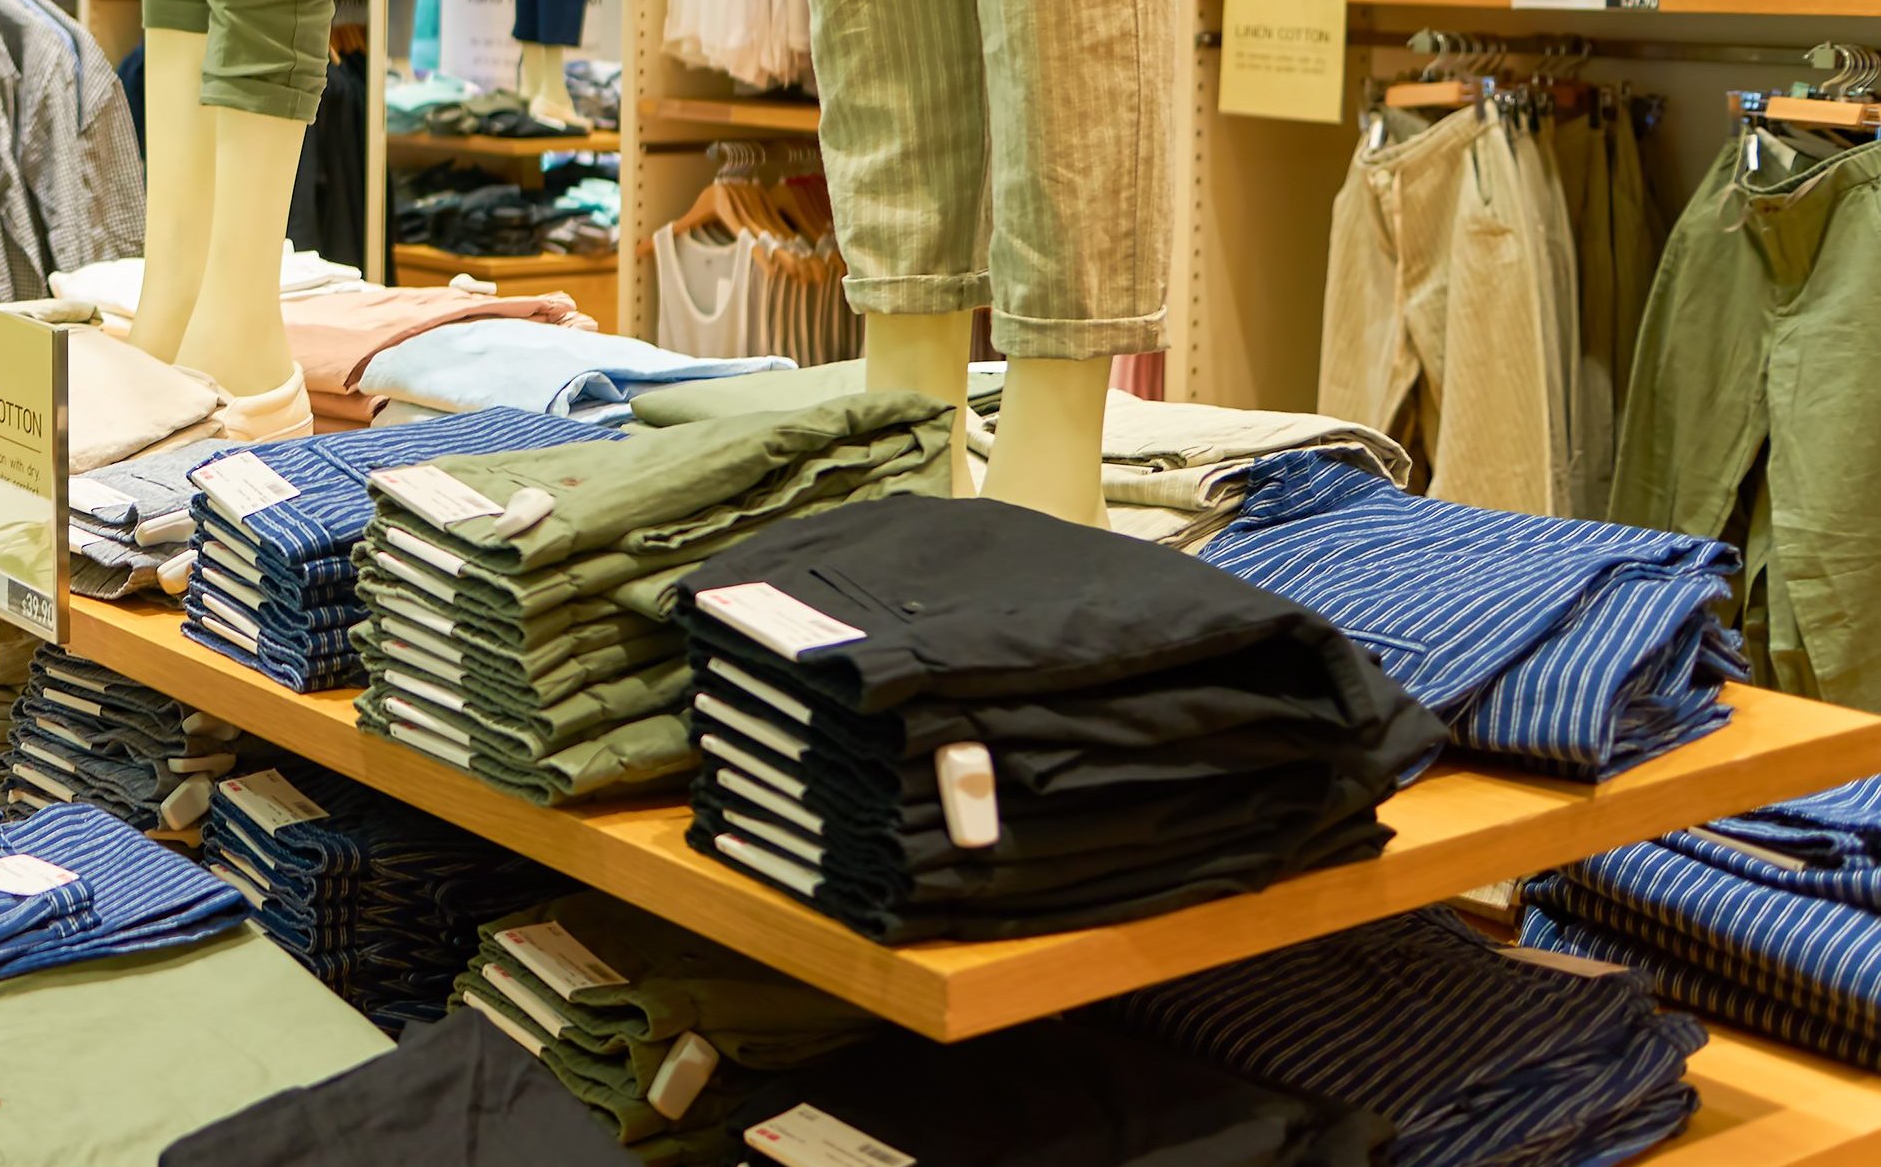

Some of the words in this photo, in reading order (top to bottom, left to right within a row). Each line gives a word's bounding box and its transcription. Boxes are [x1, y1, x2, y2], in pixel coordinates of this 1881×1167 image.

[1277, 26, 1329, 45] COTTON
[9, 457, 24, 473] with
[21, 592, 53, 627] $39.90
